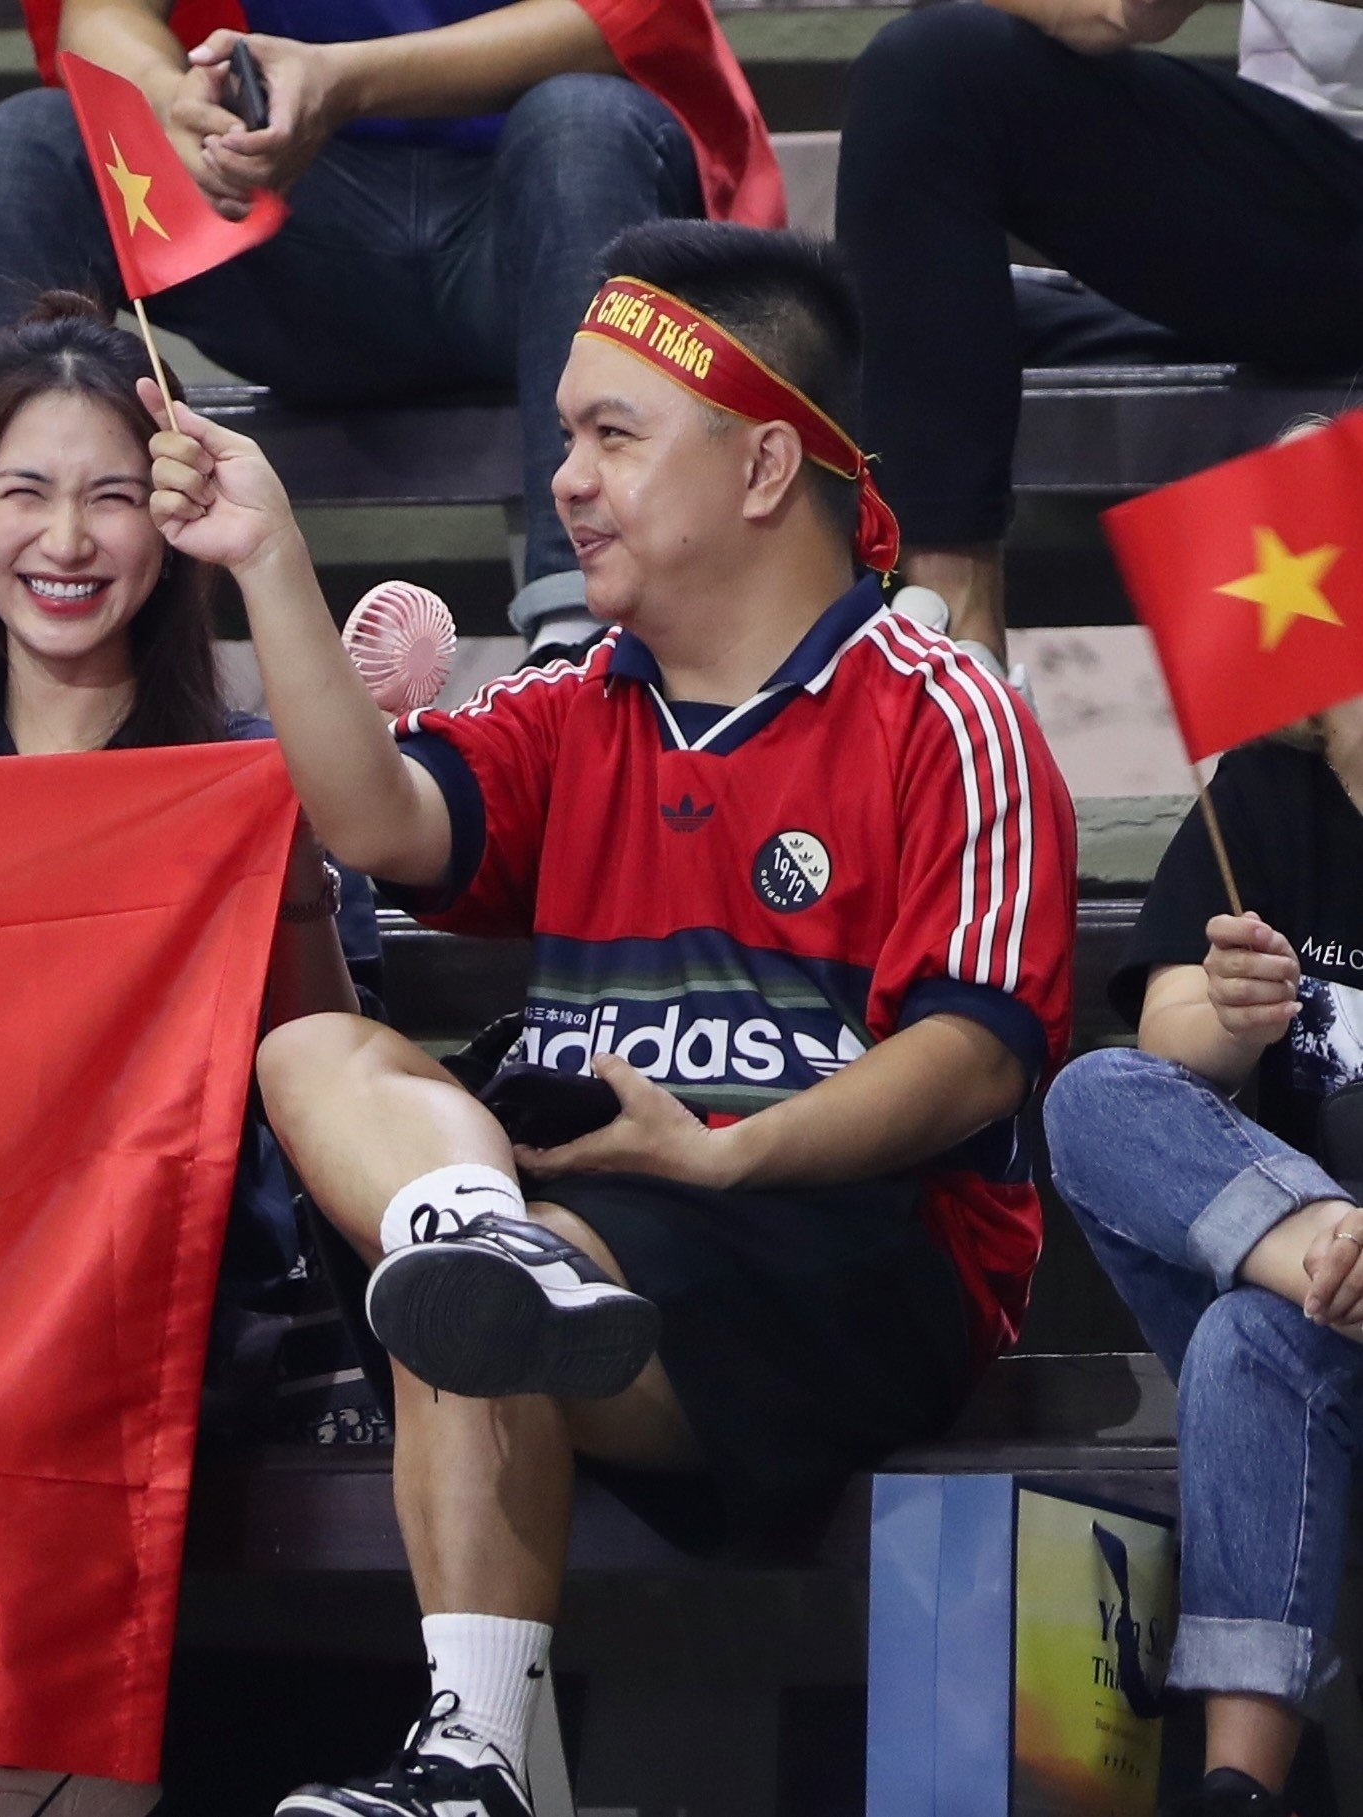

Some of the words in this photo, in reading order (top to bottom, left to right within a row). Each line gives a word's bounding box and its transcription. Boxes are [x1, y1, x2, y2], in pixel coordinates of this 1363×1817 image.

[597, 291, 655, 339] CHIẾN
[647, 314, 714, 380] THẮNG
[773, 847, 806, 902] 1972
